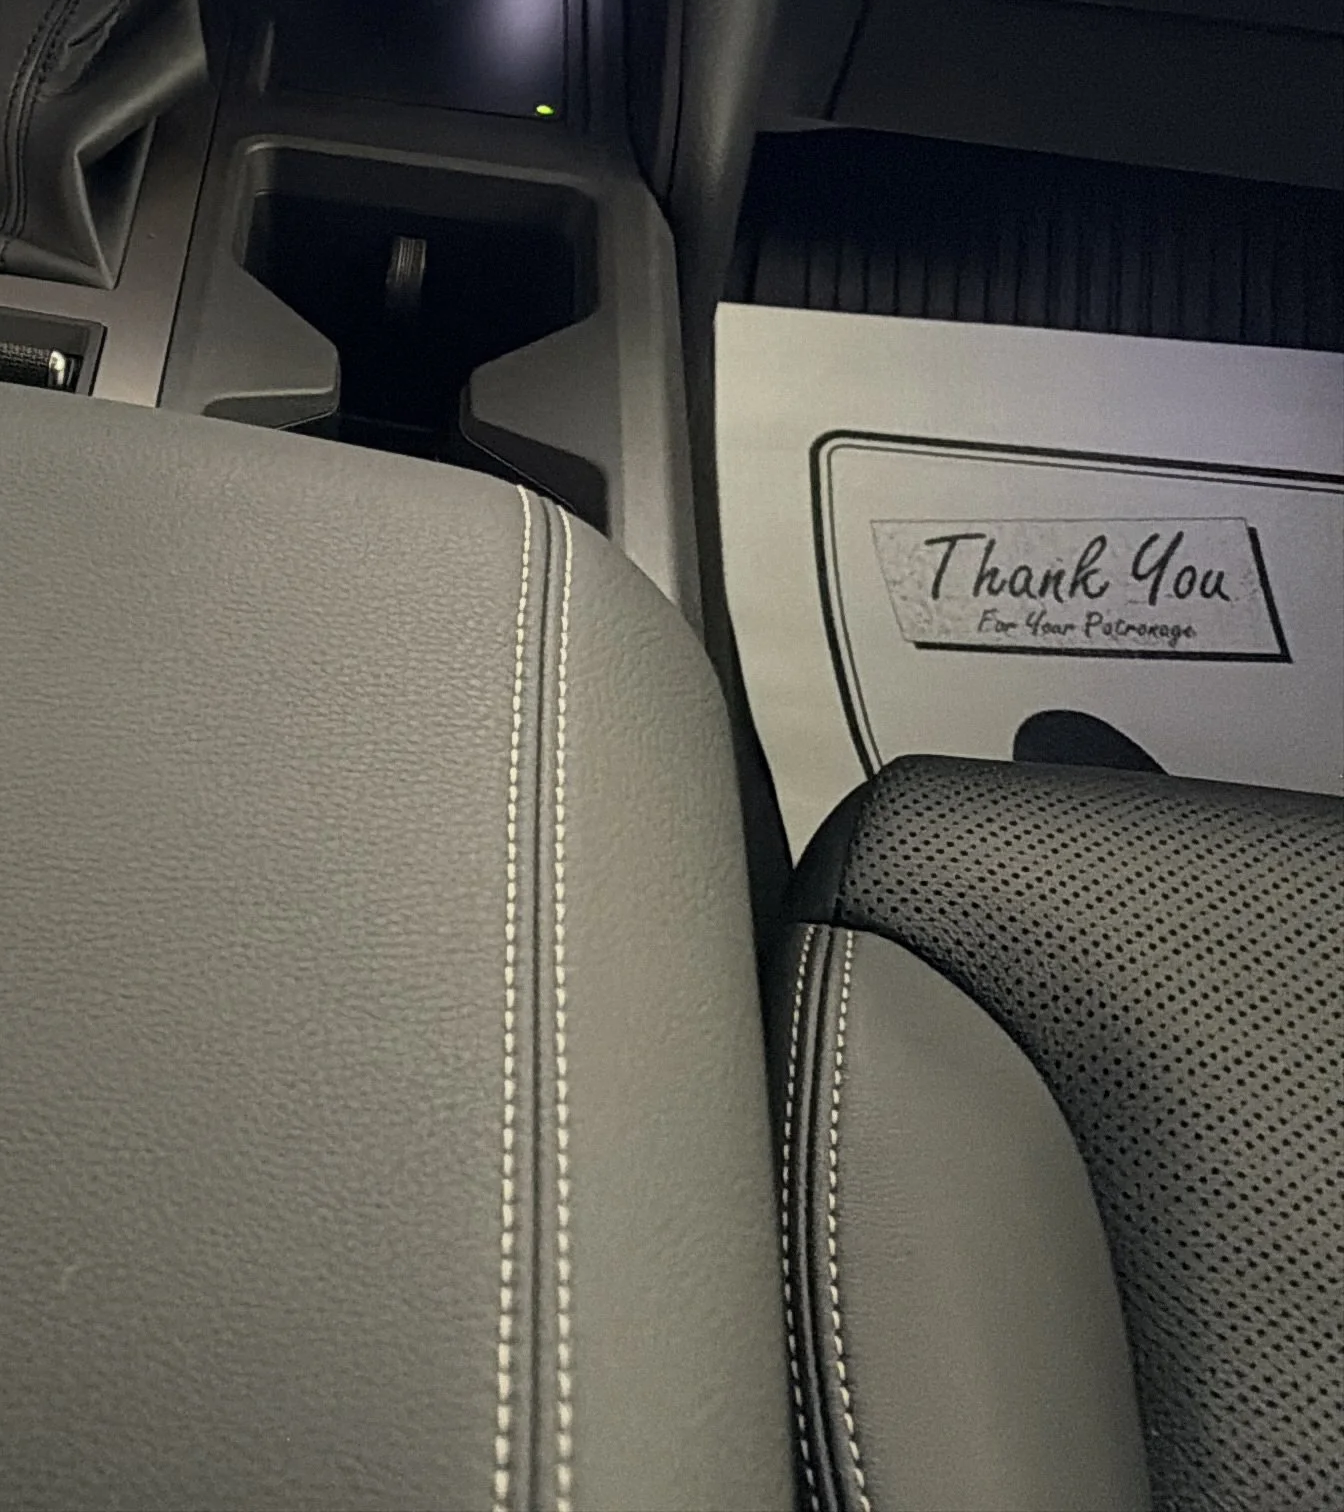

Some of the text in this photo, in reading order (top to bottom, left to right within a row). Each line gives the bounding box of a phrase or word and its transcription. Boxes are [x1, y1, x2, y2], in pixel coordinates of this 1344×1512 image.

[923, 530, 1232, 607] Thank You
[977, 608, 1018, 634] For
[1024, 610, 1076, 637] Your
